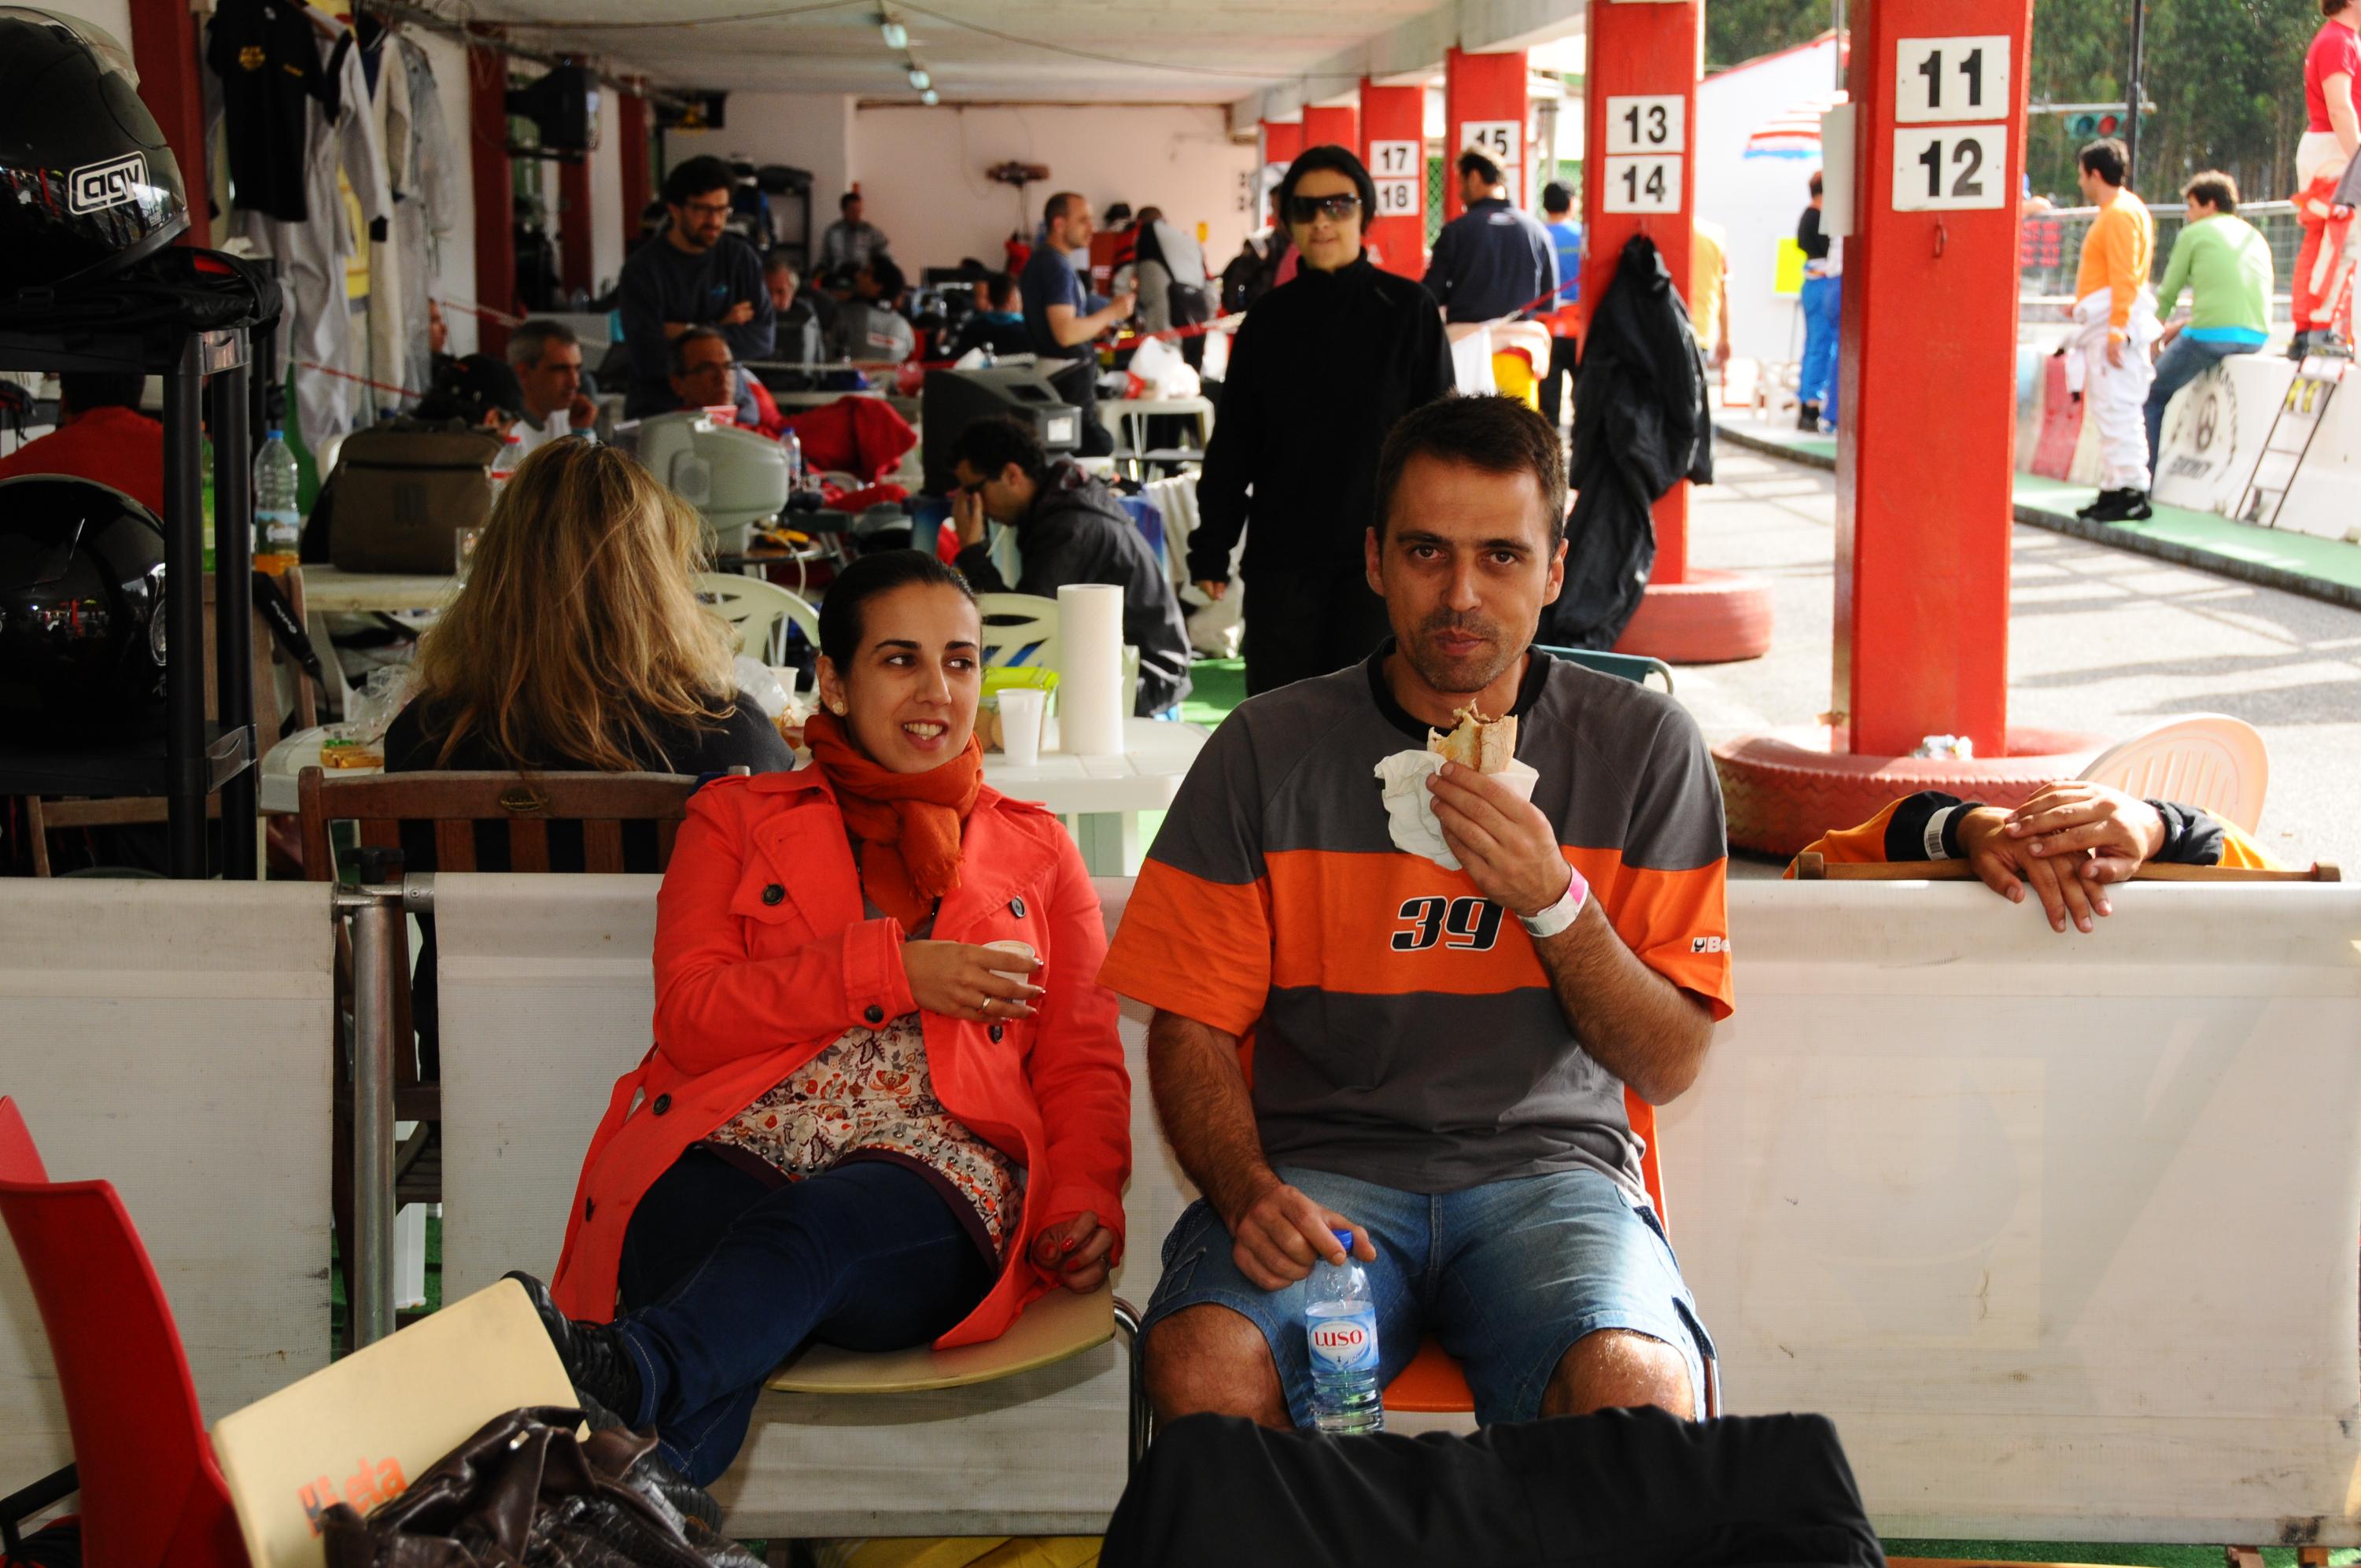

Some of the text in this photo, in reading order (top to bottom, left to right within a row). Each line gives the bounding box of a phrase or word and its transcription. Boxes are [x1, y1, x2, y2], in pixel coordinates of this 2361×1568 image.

[1920, 49, 1982, 107] 11
[1476, 130, 1508, 157] 15
[1625, 105, 1666, 144] 13
[1382, 147, 1407, 170] 17
[1919, 138, 1983, 197] 12
[83, 164, 140, 205] agv
[1382, 184, 1407, 208] 18
[1623, 165, 1666, 203] 14
[1390, 895, 1505, 951] 39
[1315, 1329, 1362, 1346] LUSO
